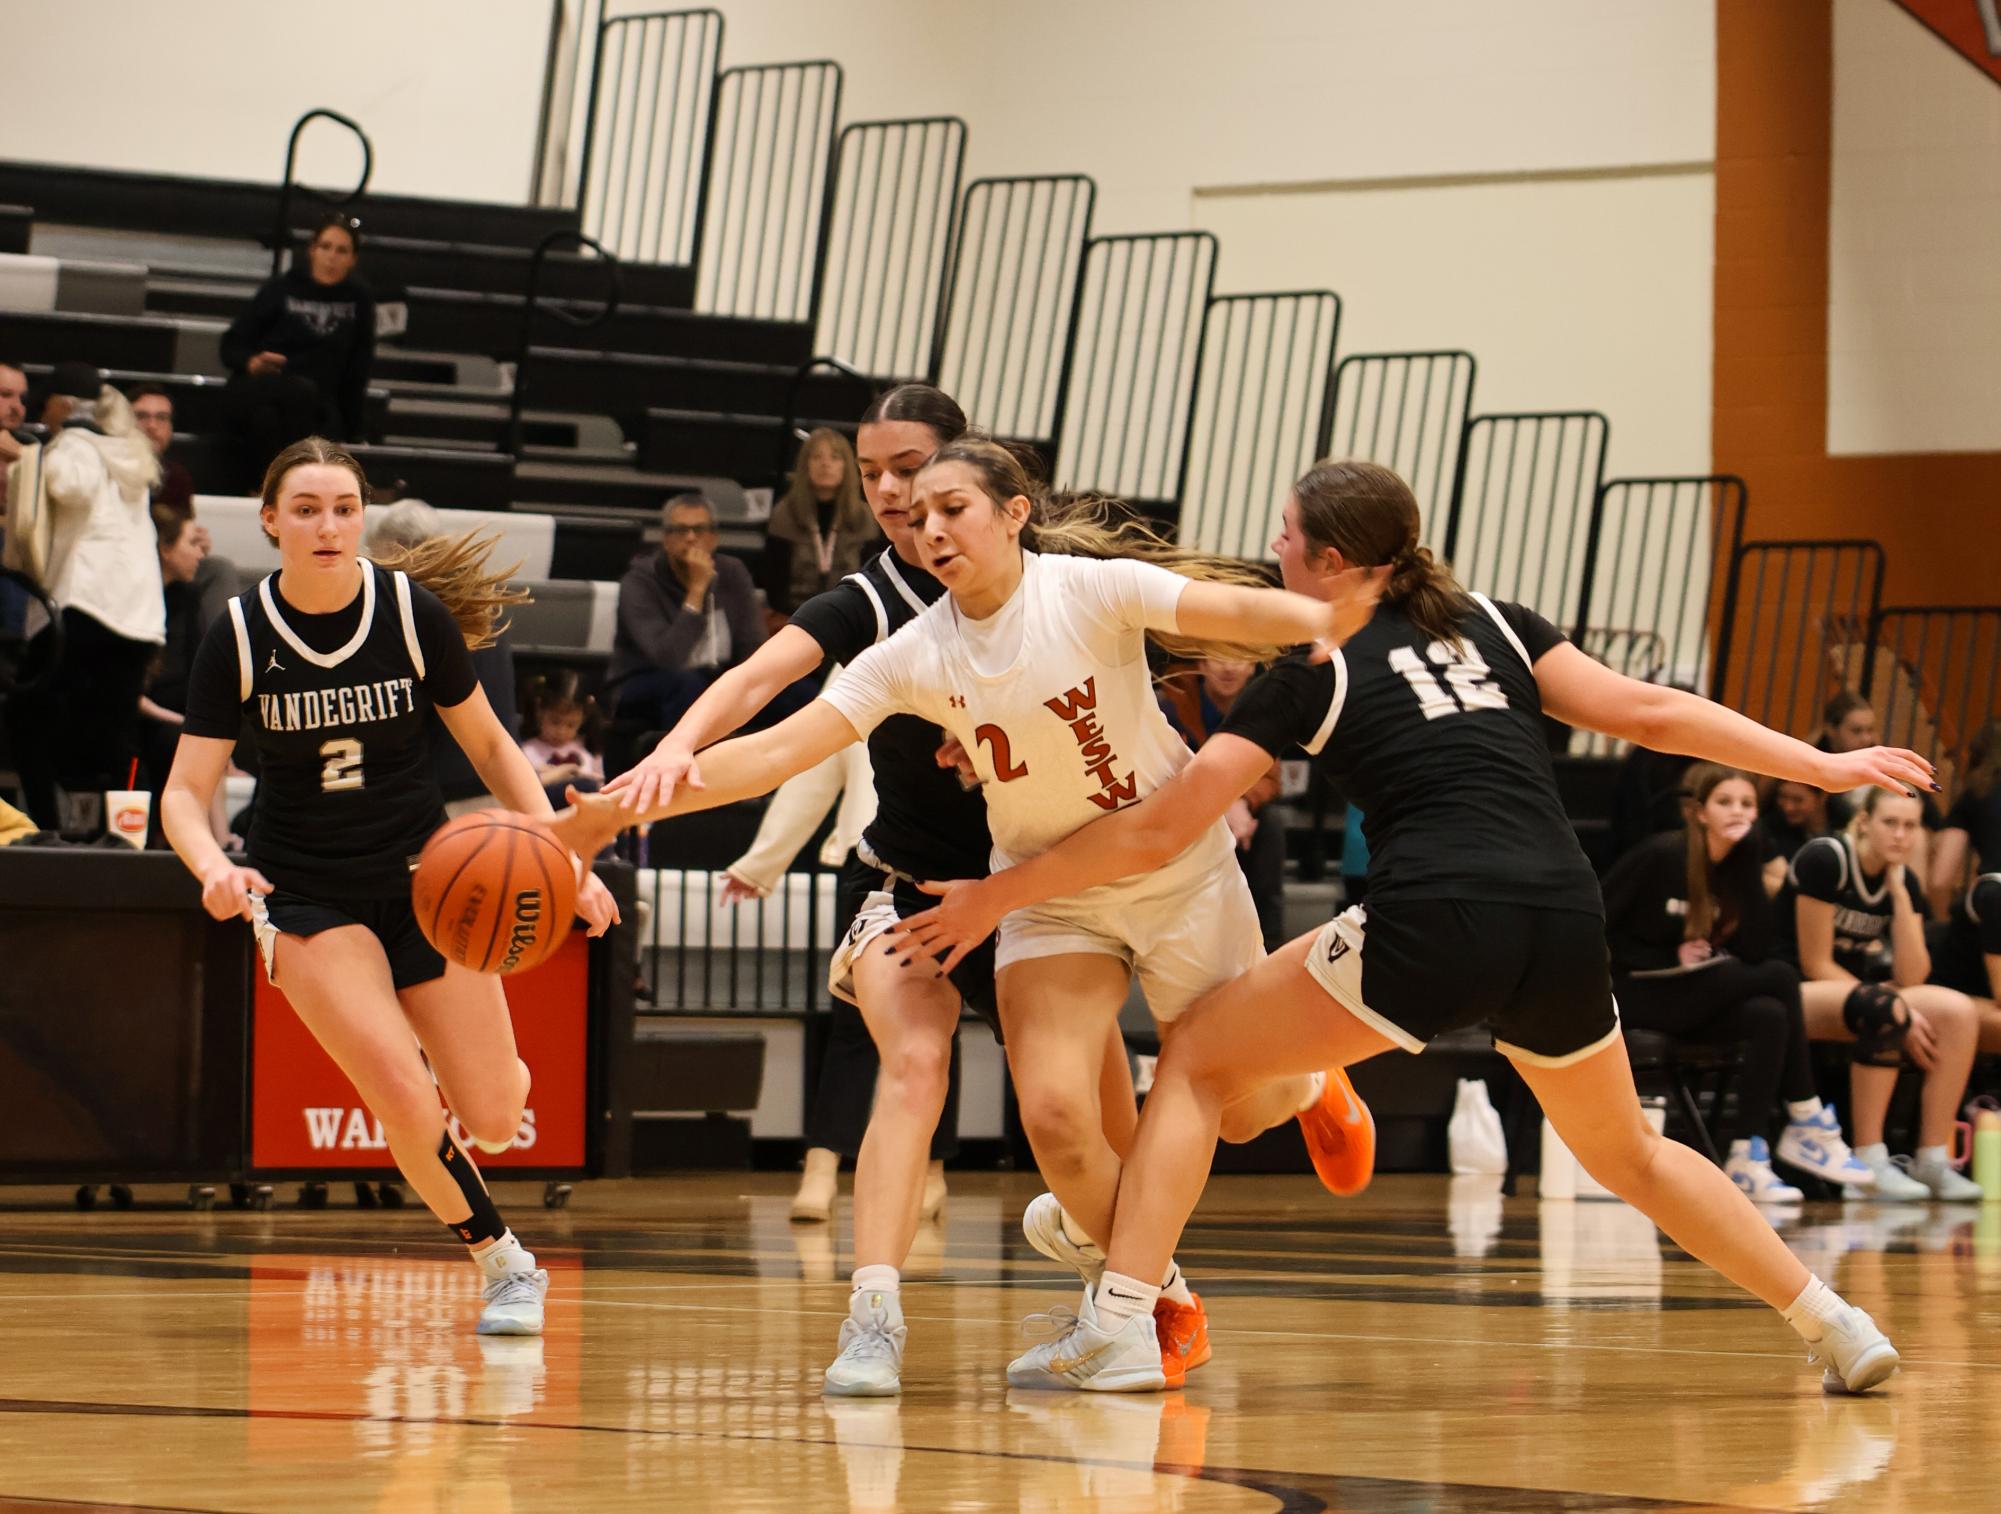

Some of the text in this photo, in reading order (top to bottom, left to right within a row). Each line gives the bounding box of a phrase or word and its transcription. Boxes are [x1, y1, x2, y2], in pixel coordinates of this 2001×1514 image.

[257, 677, 415, 732] VANDEGRIFT
[1387, 636, 1510, 721] 12
[319, 736, 366, 793] 2
[975, 723, 1029, 783] 2
